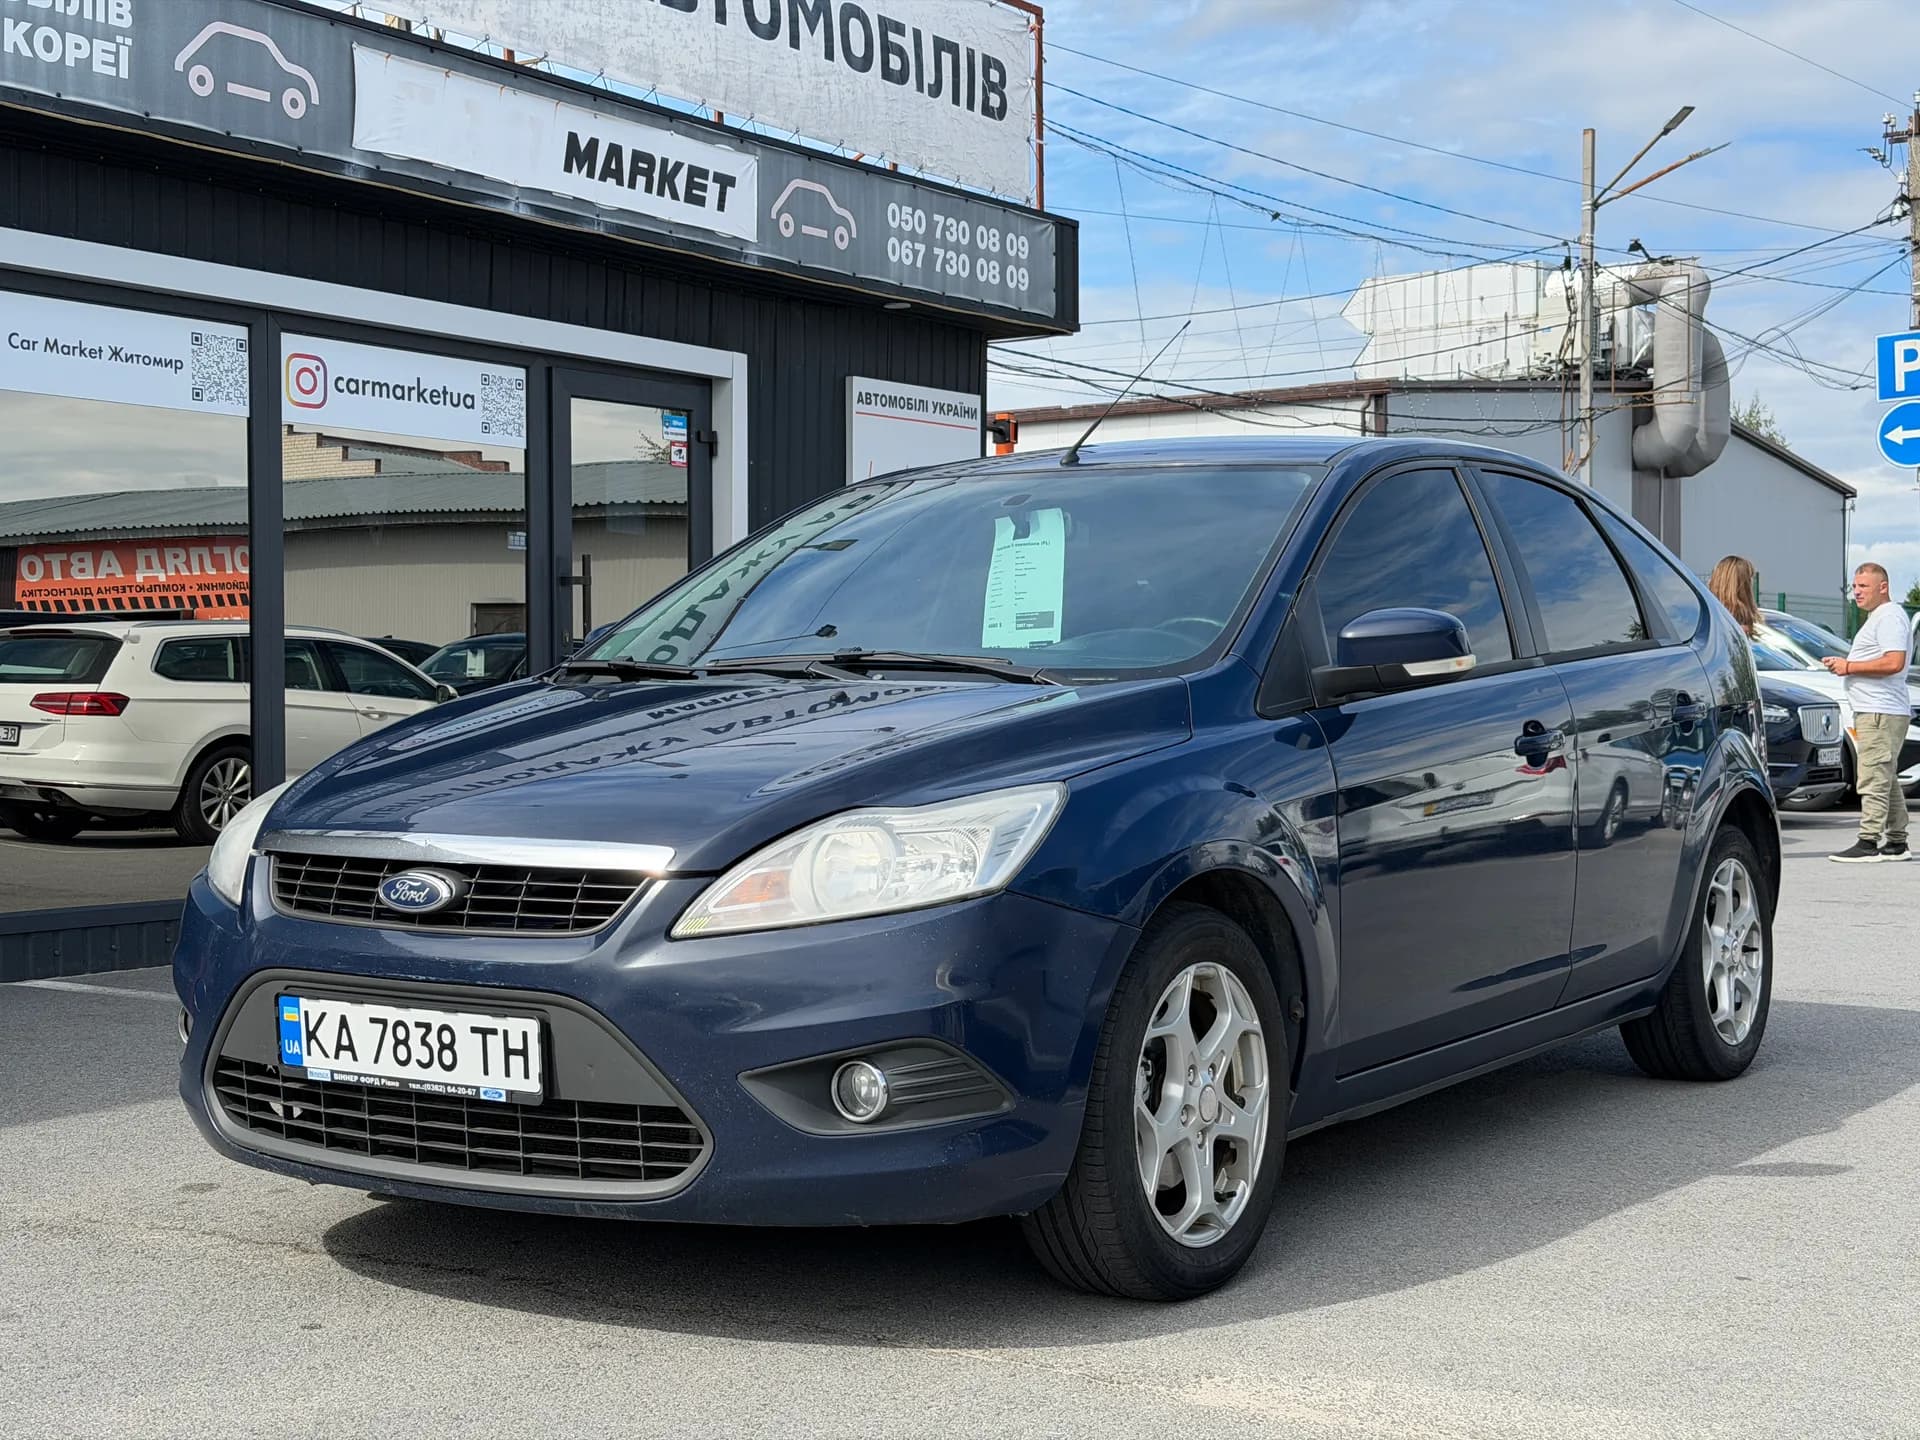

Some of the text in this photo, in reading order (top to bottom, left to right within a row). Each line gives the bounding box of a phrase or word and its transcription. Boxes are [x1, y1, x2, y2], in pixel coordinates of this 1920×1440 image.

[4, 17, 132, 79] КОРЕЇ
[650, 0, 1007, 121] ОМОБІЛІВ
[563, 131, 737, 212] MARKET
[887, 203, 1029, 259] 050 730 08 09
[887, 237, 1029, 291] 067 730 08 09
[8, 332, 184, 374] Car Market Житомир
[1894, 339, 1920, 392] P
[334, 377, 476, 409] carmarketua
[857, 391, 978, 421] АВТОМОБІЛІ УКРАЇНИ
[390, 880, 430, 903] Ford
[285, 1039, 301, 1055] UA
[304, 1010, 530, 1080] KA 7838 TH
